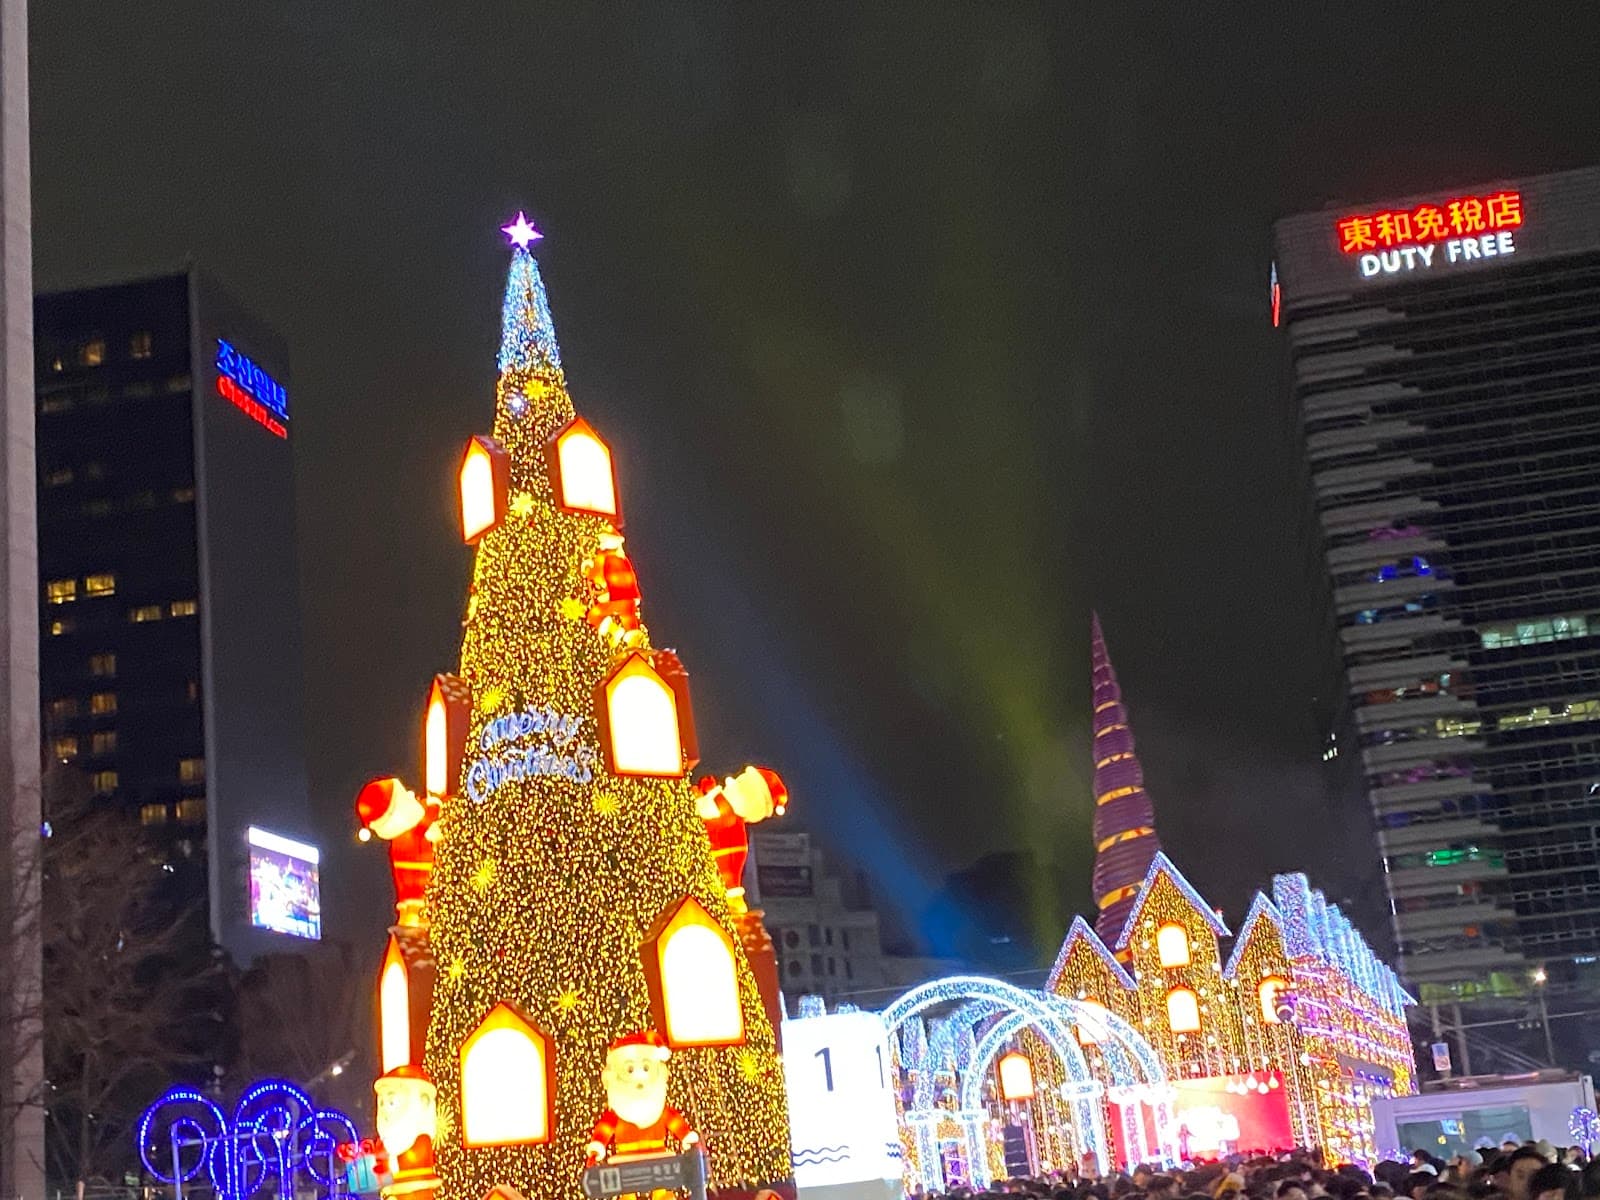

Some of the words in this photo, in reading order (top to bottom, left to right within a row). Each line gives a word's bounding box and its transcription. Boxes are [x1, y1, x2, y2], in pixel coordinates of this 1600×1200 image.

[1360, 244, 1436, 277] DUTY
[1446, 231, 1516, 263] FREE
[216, 337, 290, 421] 조선일보
[814, 1046, 834, 1092] 1
